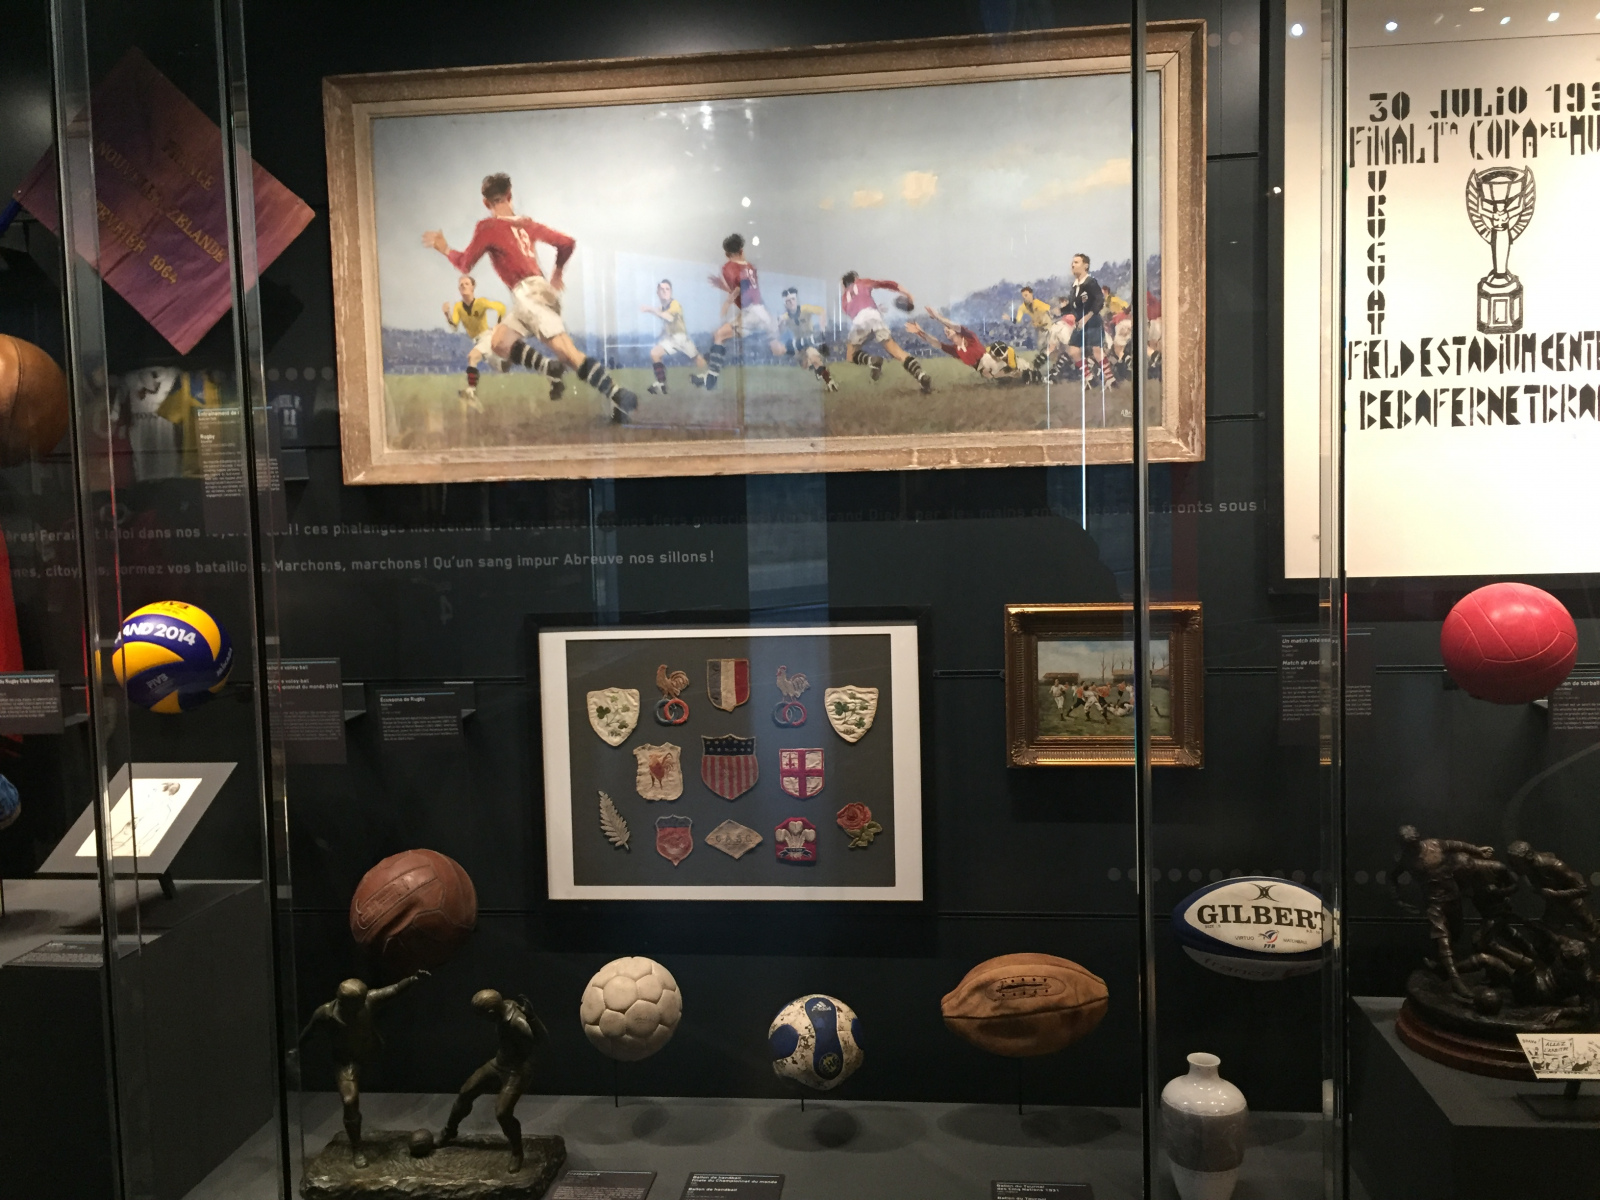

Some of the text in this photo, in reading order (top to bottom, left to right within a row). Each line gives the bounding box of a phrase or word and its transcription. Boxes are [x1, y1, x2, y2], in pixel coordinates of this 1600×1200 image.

[1369, 92, 1410, 122] 30
[1469, 118, 1538, 160] COPA
[1367, 170, 1387, 335] URUGUAY
[149, 254, 177, 284] 1964
[1541, 330, 1600, 372] CENT
[138, 526, 171, 539] dans
[176, 527, 201, 538] nos
[304, 525, 329, 535] ces
[1218, 501, 1258, 512] sous
[167, 563, 191, 574] vos
[275, 559, 346, 573] Marchons,
[433, 555, 474, 569] Qu'un
[478, 556, 513, 571] sang
[517, 554, 560, 570] impur
[563, 552, 624, 566] Abreuve
[629, 552, 655, 565] nos
[154, 623, 196, 646] 2014
[1197, 904, 1326, 930] GILBERT
